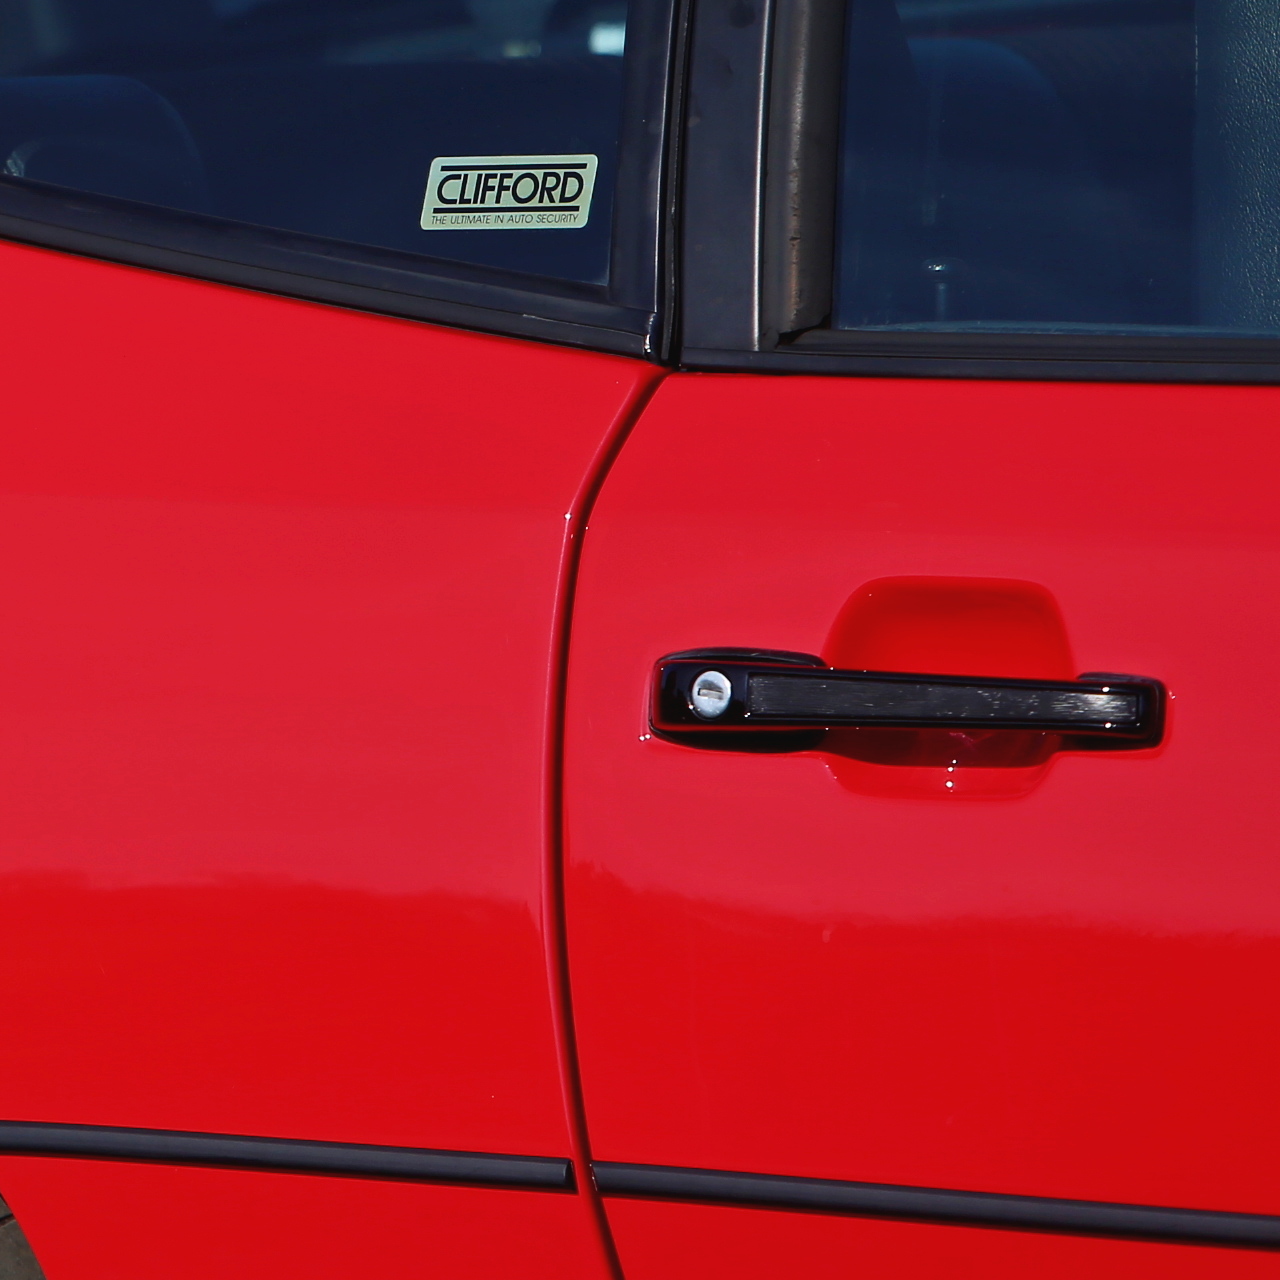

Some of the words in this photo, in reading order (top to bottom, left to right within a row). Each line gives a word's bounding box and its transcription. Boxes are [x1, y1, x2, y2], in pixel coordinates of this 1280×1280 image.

[437, 172, 583, 204] CLIFFORD
[431, 216, 447, 225] THE
[450, 214, 491, 225] ULTIMATE
[494, 215, 505, 224] IN
[507, 214, 534, 224] AUTO
[535, 213, 579, 224] SECURITY
